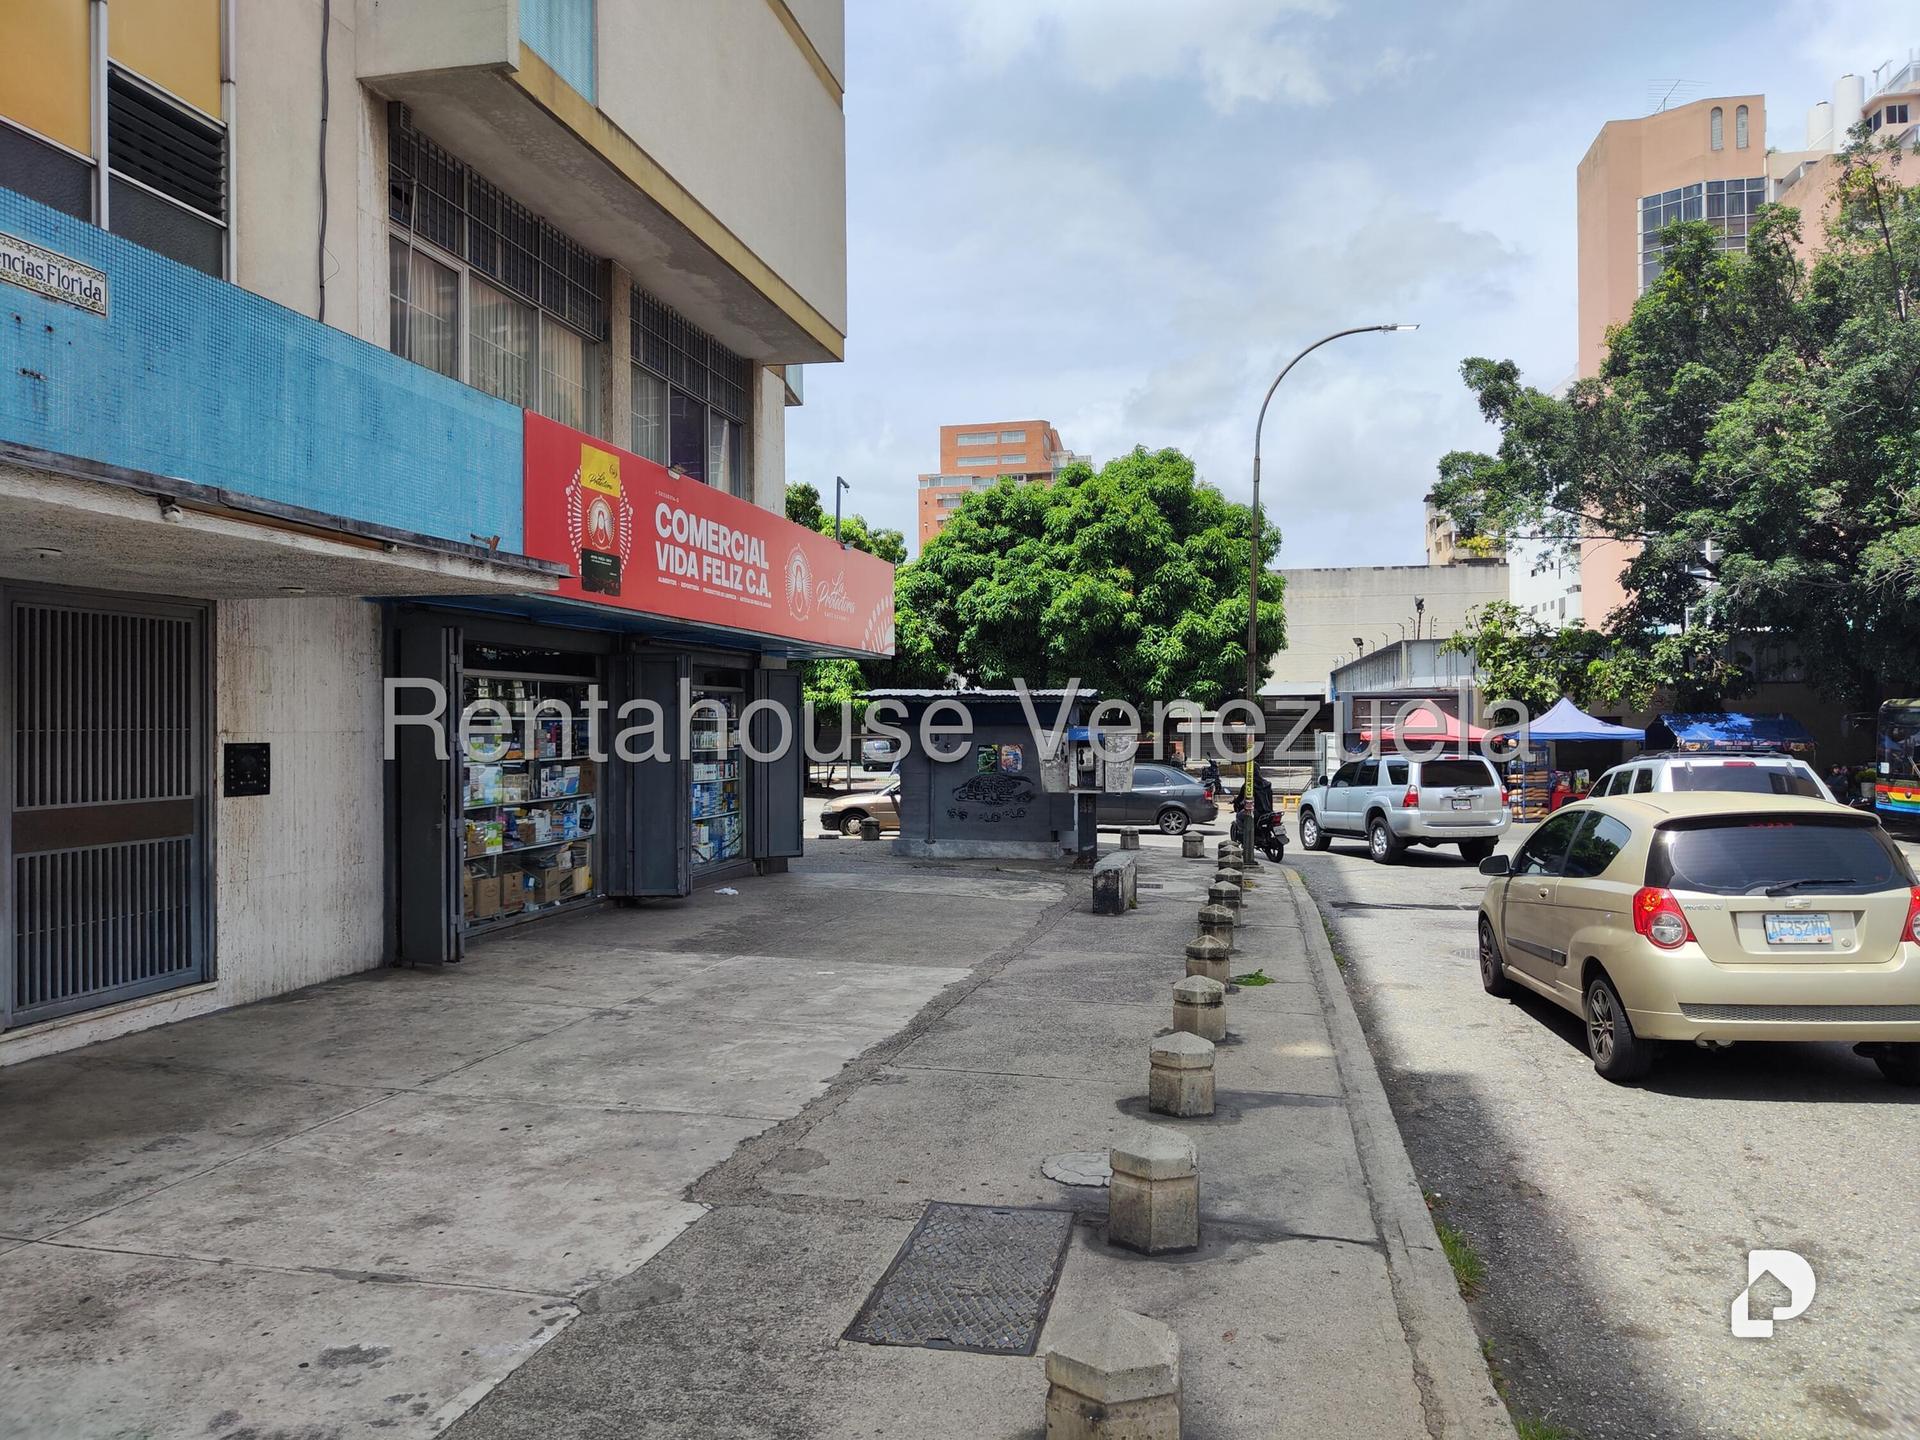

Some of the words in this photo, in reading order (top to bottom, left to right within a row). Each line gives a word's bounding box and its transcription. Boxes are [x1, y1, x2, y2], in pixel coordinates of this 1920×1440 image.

[655, 502, 769, 570] COMERCIAL
[655, 541, 699, 580] VIDA
[702, 555, 744, 591] FELIZ
[745, 568, 772, 598] C.A.
